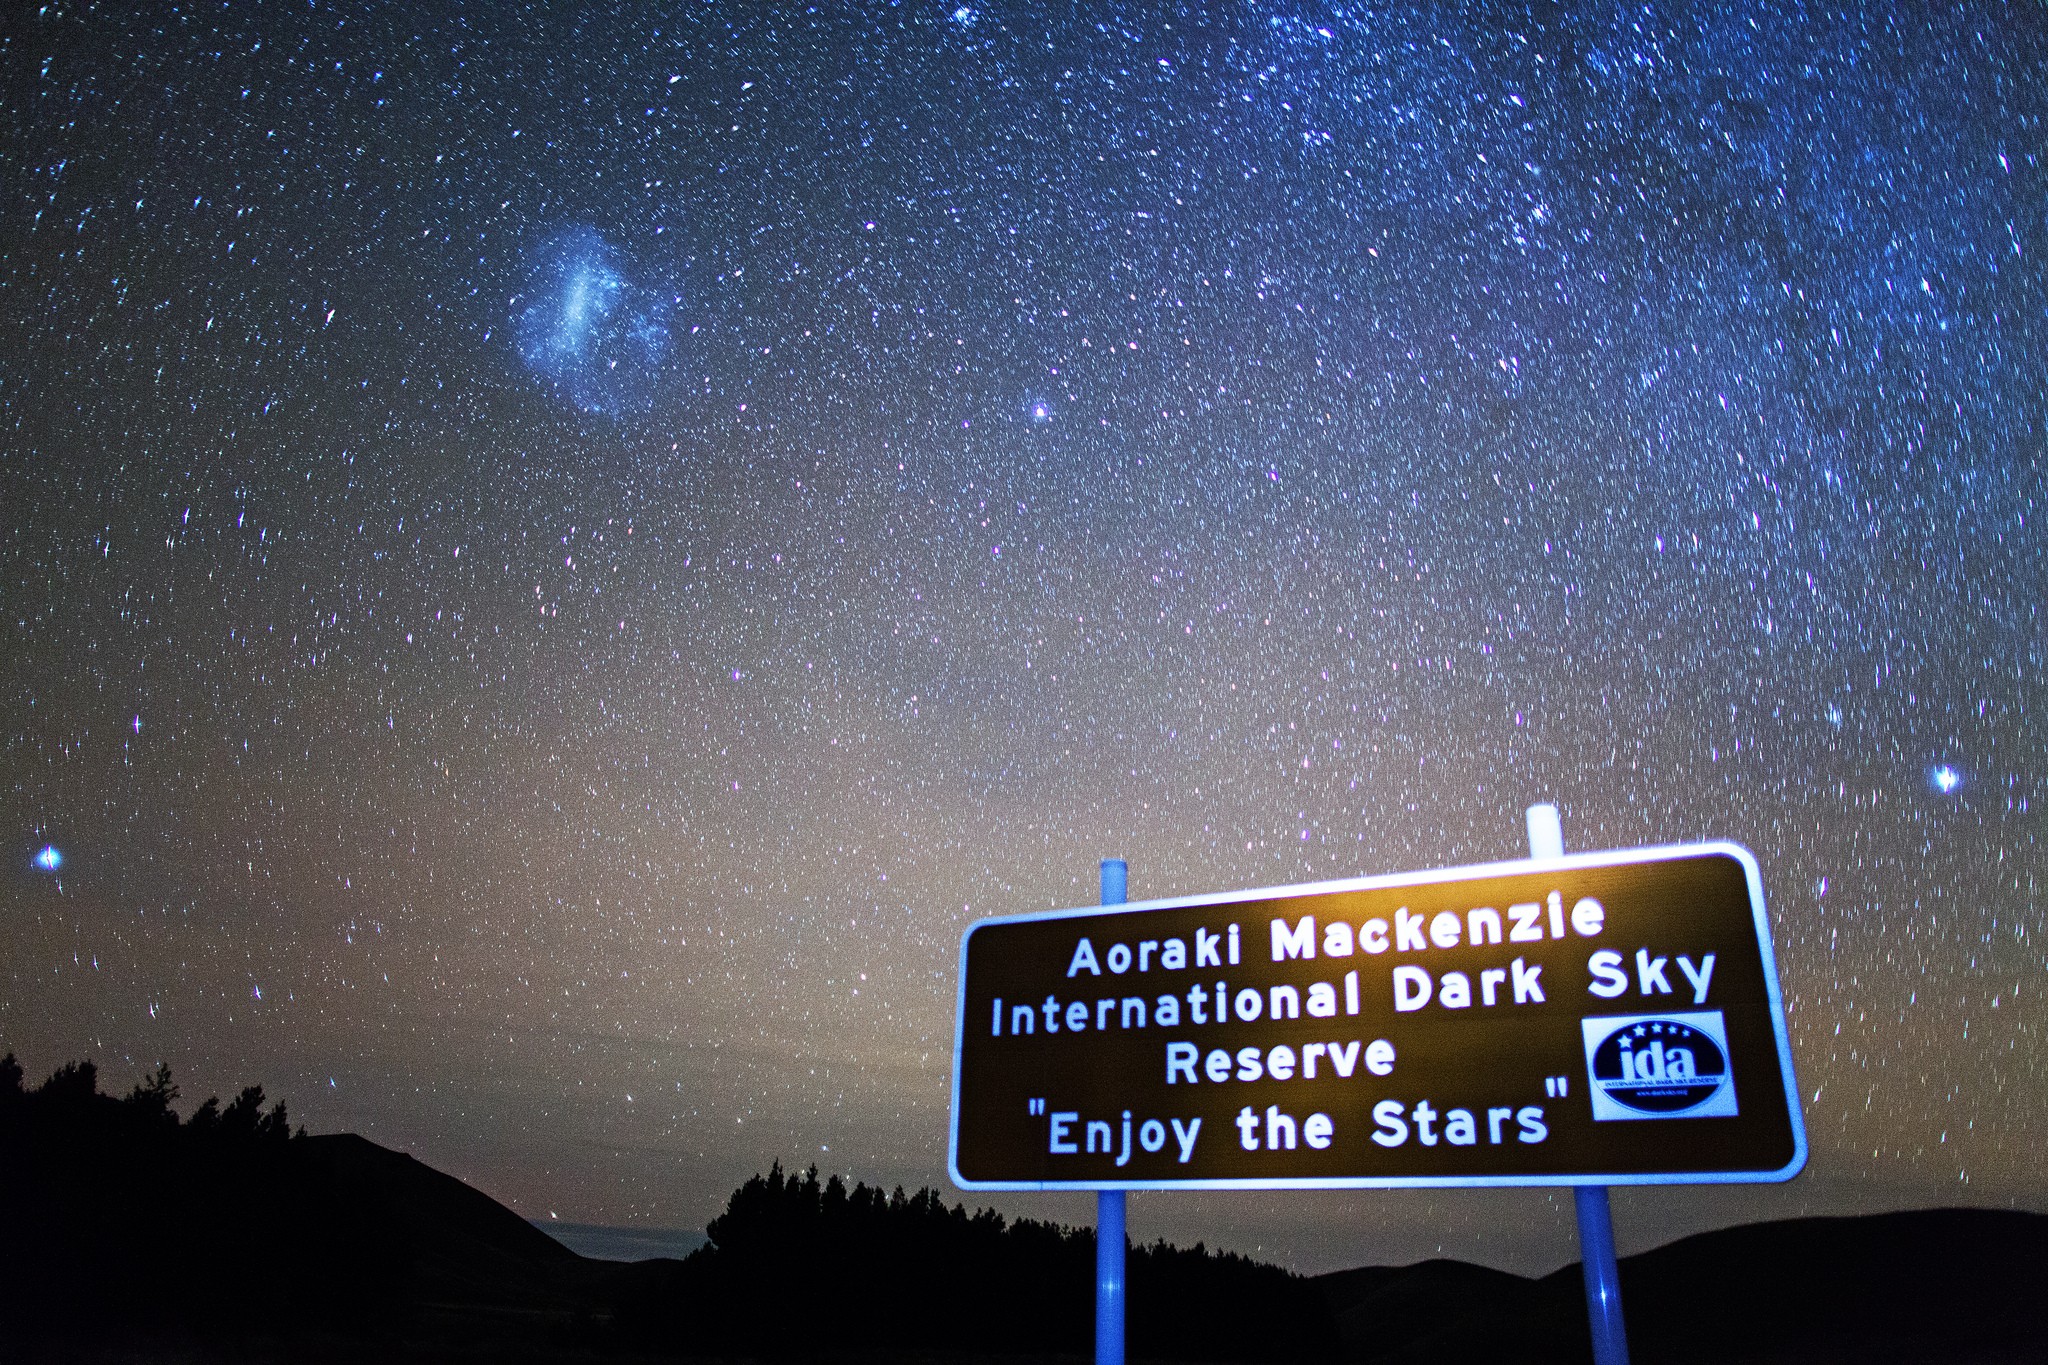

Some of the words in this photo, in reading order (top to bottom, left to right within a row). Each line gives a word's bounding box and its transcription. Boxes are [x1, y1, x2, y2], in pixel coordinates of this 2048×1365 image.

[1067, 923, 1241, 977] Aoraki
[1270, 890, 1605, 962] Mackenzie
[992, 969, 1360, 1036] International
[1393, 956, 1547, 1012] Dark
[1588, 947, 1717, 1004] Sky
[1166, 1039, 1396, 1084] Reserve
[1619, 1036, 1696, 1080] ida
[1029, 1098, 1203, 1166] "Enjoy
[1236, 1105, 1334, 1151] the
[1371, 1076, 1569, 1148] Stars"
